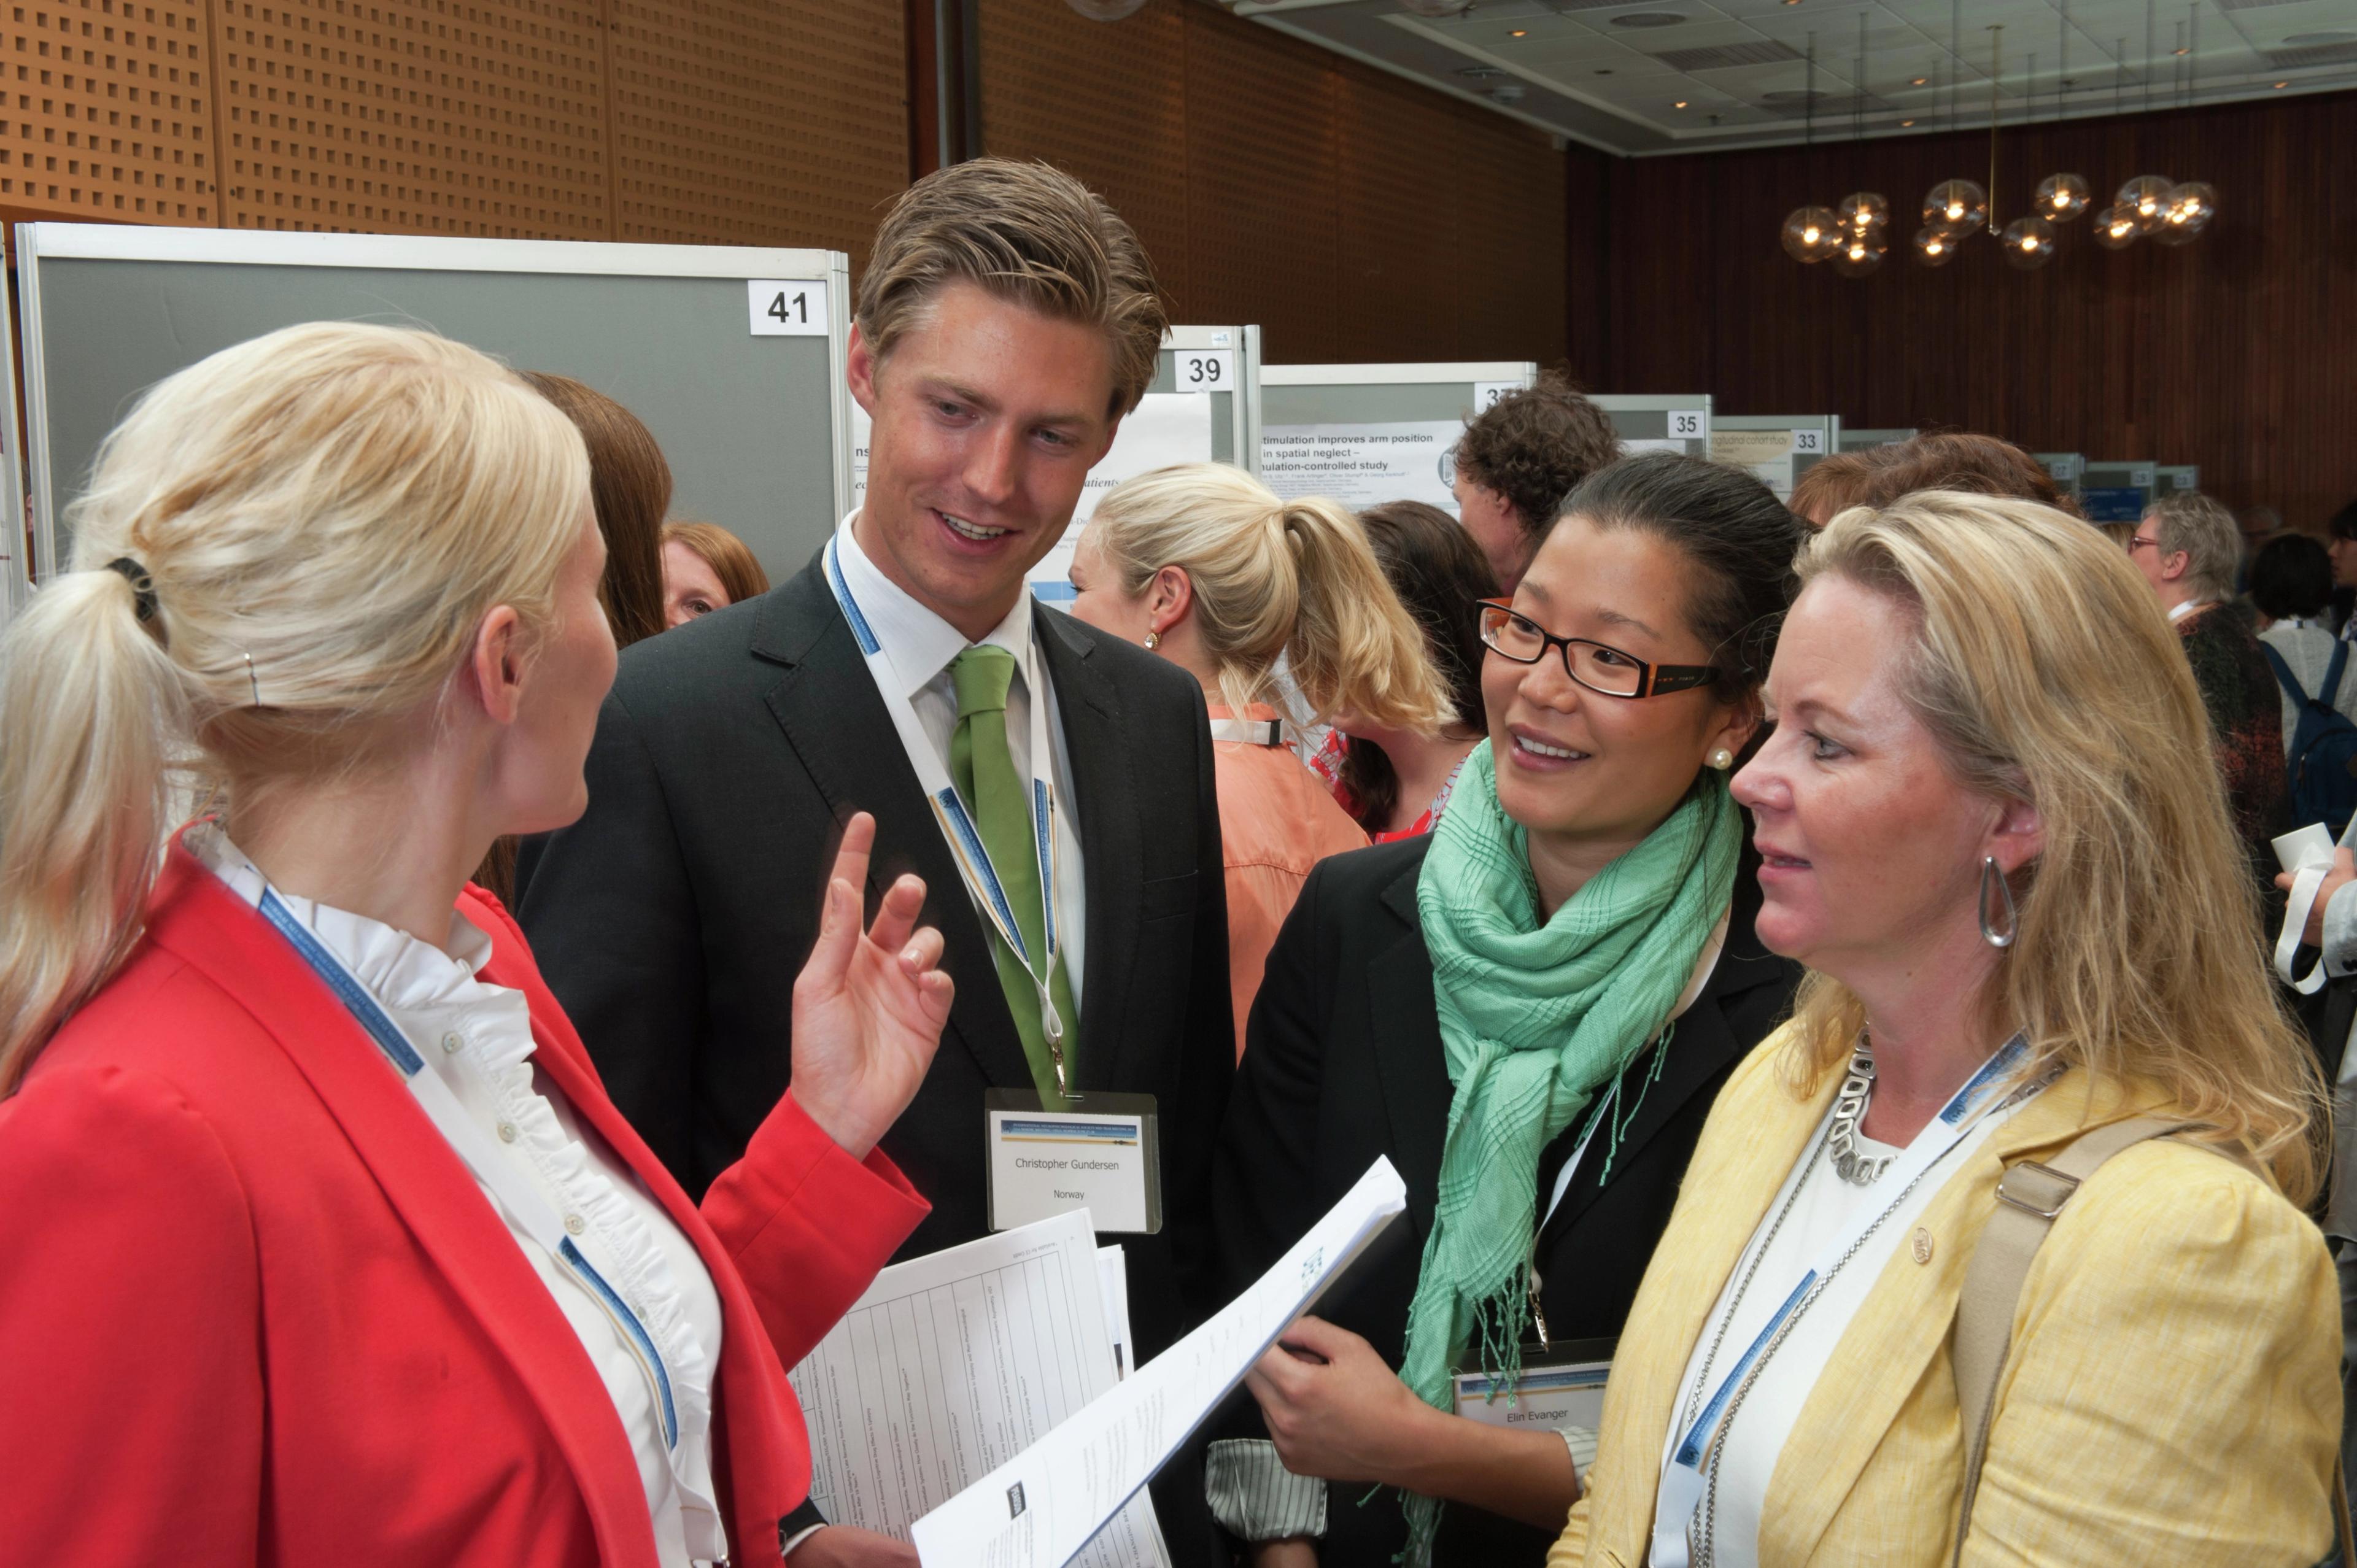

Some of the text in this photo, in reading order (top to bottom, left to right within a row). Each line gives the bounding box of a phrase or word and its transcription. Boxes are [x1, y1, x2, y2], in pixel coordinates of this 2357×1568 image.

[768, 292, 807, 323] 41
[1190, 358, 1220, 382] 39
[1677, 416, 1697, 433] 35
[1261, 435, 1314, 444] timulation
[1318, 435, 1366, 447] improves
[1392, 434, 1433, 445] position
[1746, 436, 1768, 445] cohort
[1770, 435, 1787, 446] study
[1798, 434, 1816, 448] 33
[1263, 449, 1272, 457] in
[1275, 448, 1310, 460] spatial
[1314, 448, 1351, 459] neglect
[1360, 460, 1388, 471] study
[1015, 1157, 1119, 1170] Christopher Gundersen
[1053, 1189, 1085, 1200] Norway
[1507, 1410, 1568, 1423] Elin Evanger
[1010, 1485, 1021, 1515] PEARSON
[1126, 1523, 1139, 1560] CHANGING
